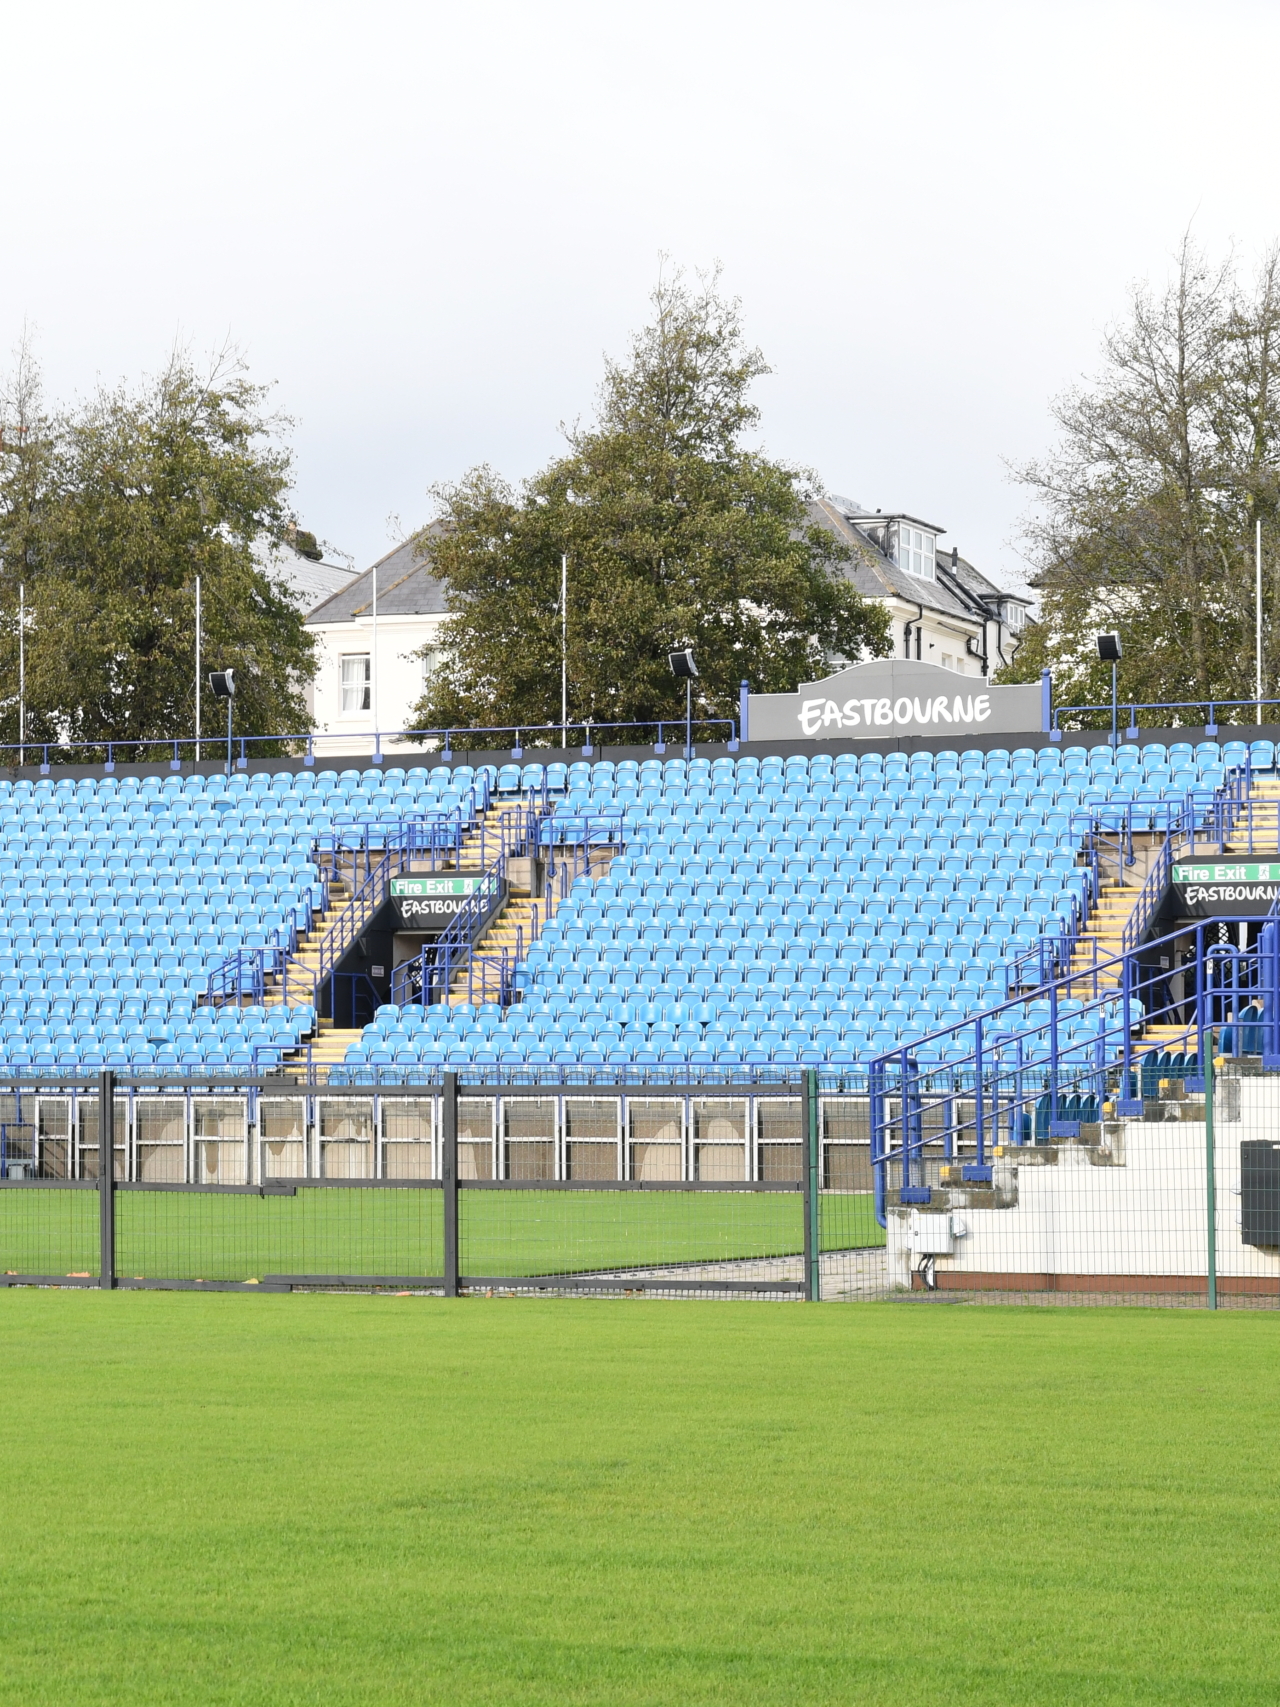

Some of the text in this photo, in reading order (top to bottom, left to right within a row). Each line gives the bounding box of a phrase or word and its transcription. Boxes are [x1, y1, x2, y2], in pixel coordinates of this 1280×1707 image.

[798, 695, 991, 735] EASTBOURNE
[1178, 866, 1247, 880] Fire Exit
[396, 880, 454, 894] Fire Exit
[1185, 886, 1280, 905] EASTBOURN
